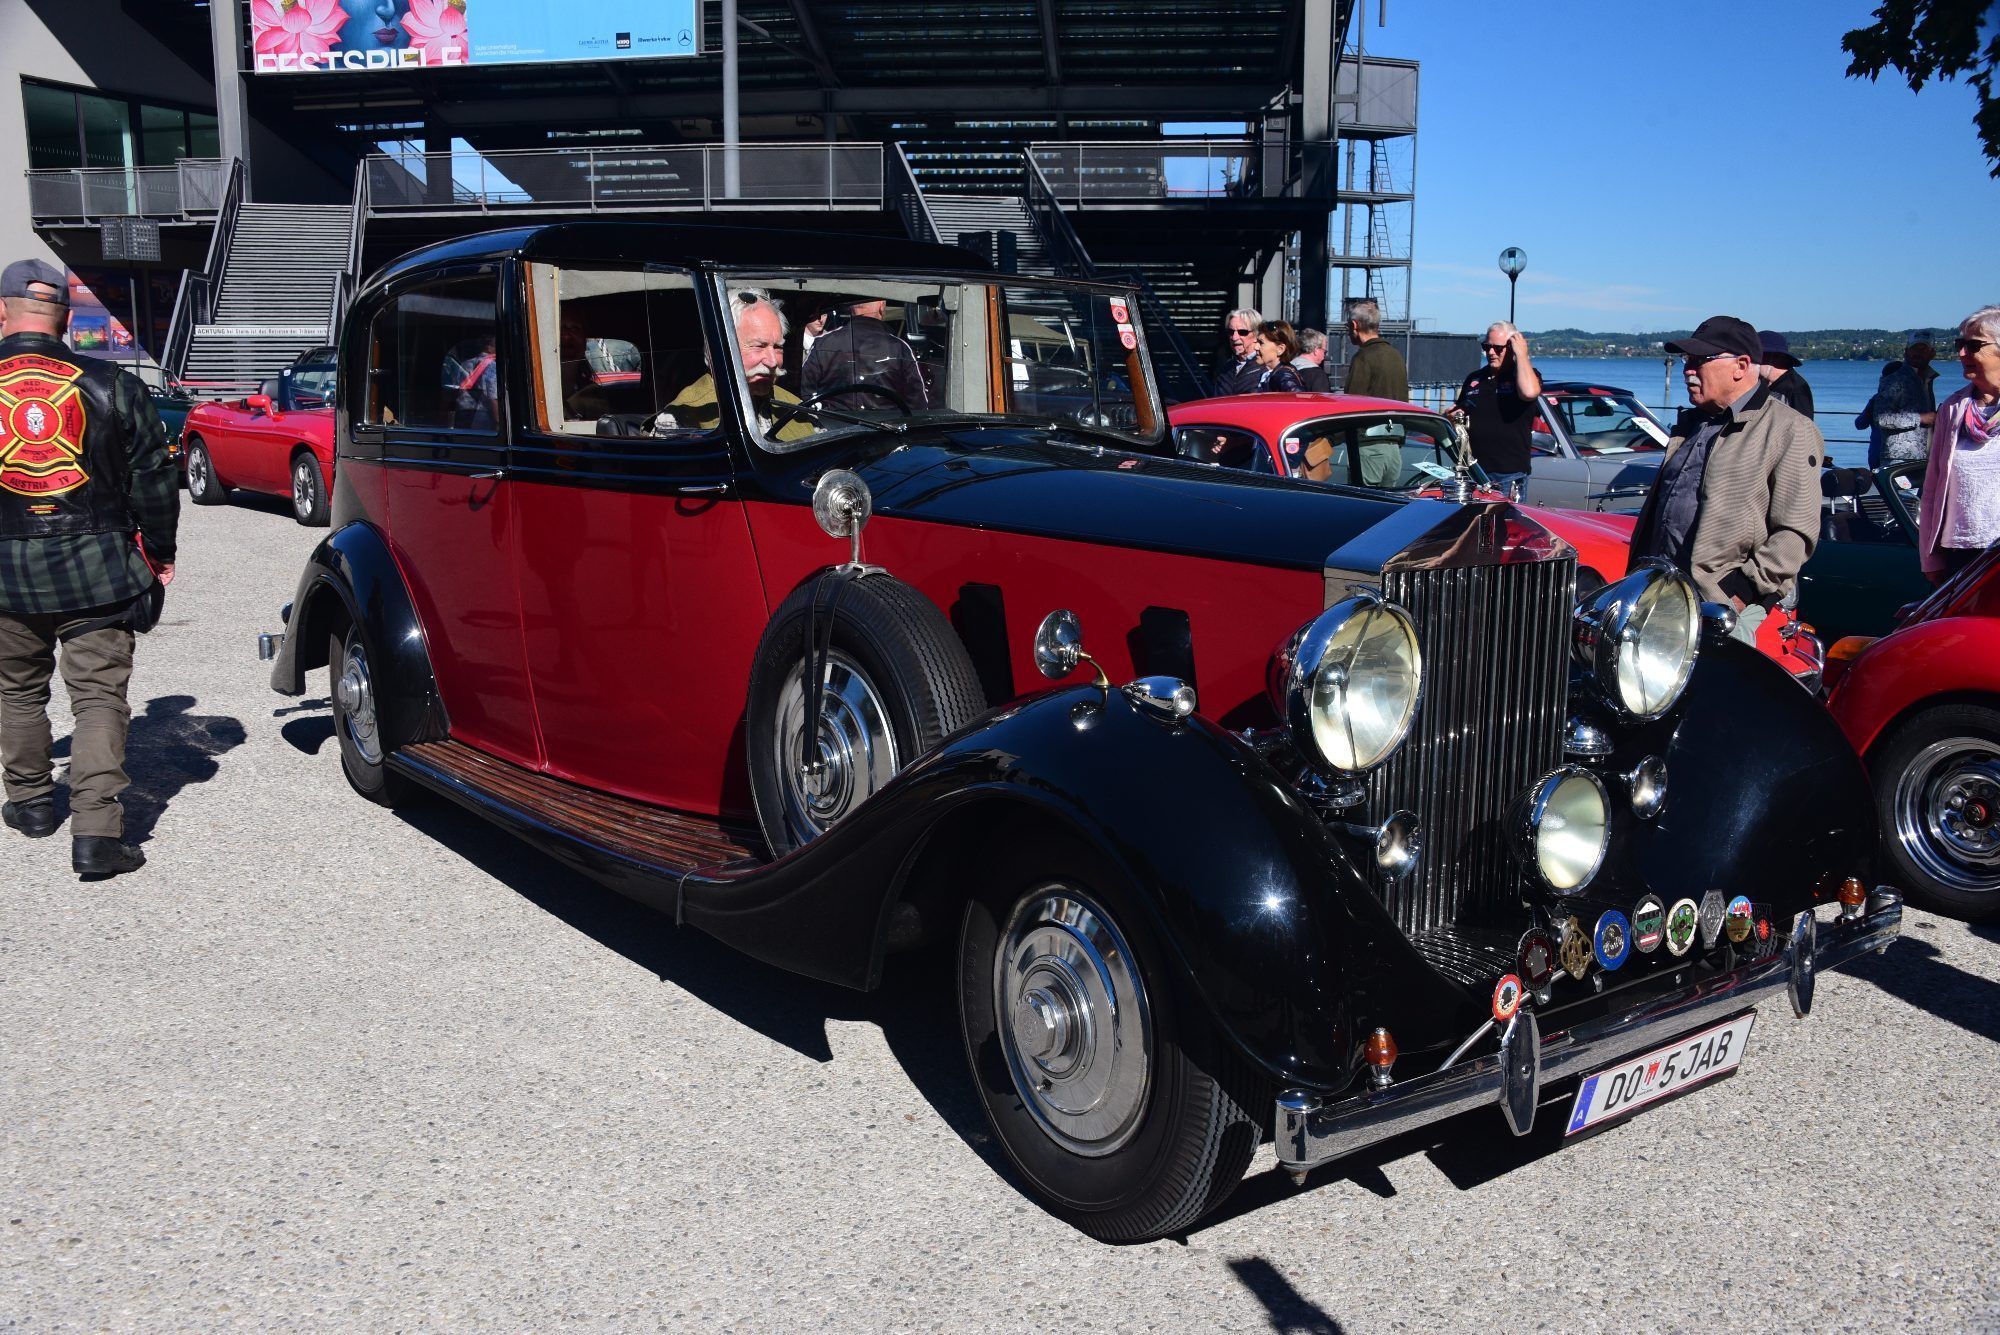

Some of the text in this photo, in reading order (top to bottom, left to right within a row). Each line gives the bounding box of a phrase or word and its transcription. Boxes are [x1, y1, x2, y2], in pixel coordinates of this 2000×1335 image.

[257, 46, 462, 72] FESTSPIELE
[0, 358, 64, 372] ED KNIGHTS
[14, 387, 51, 395] KNIGHTS
[9, 475, 70, 490] AUSTRIA IV
[1603, 1065, 1644, 1112] DO
